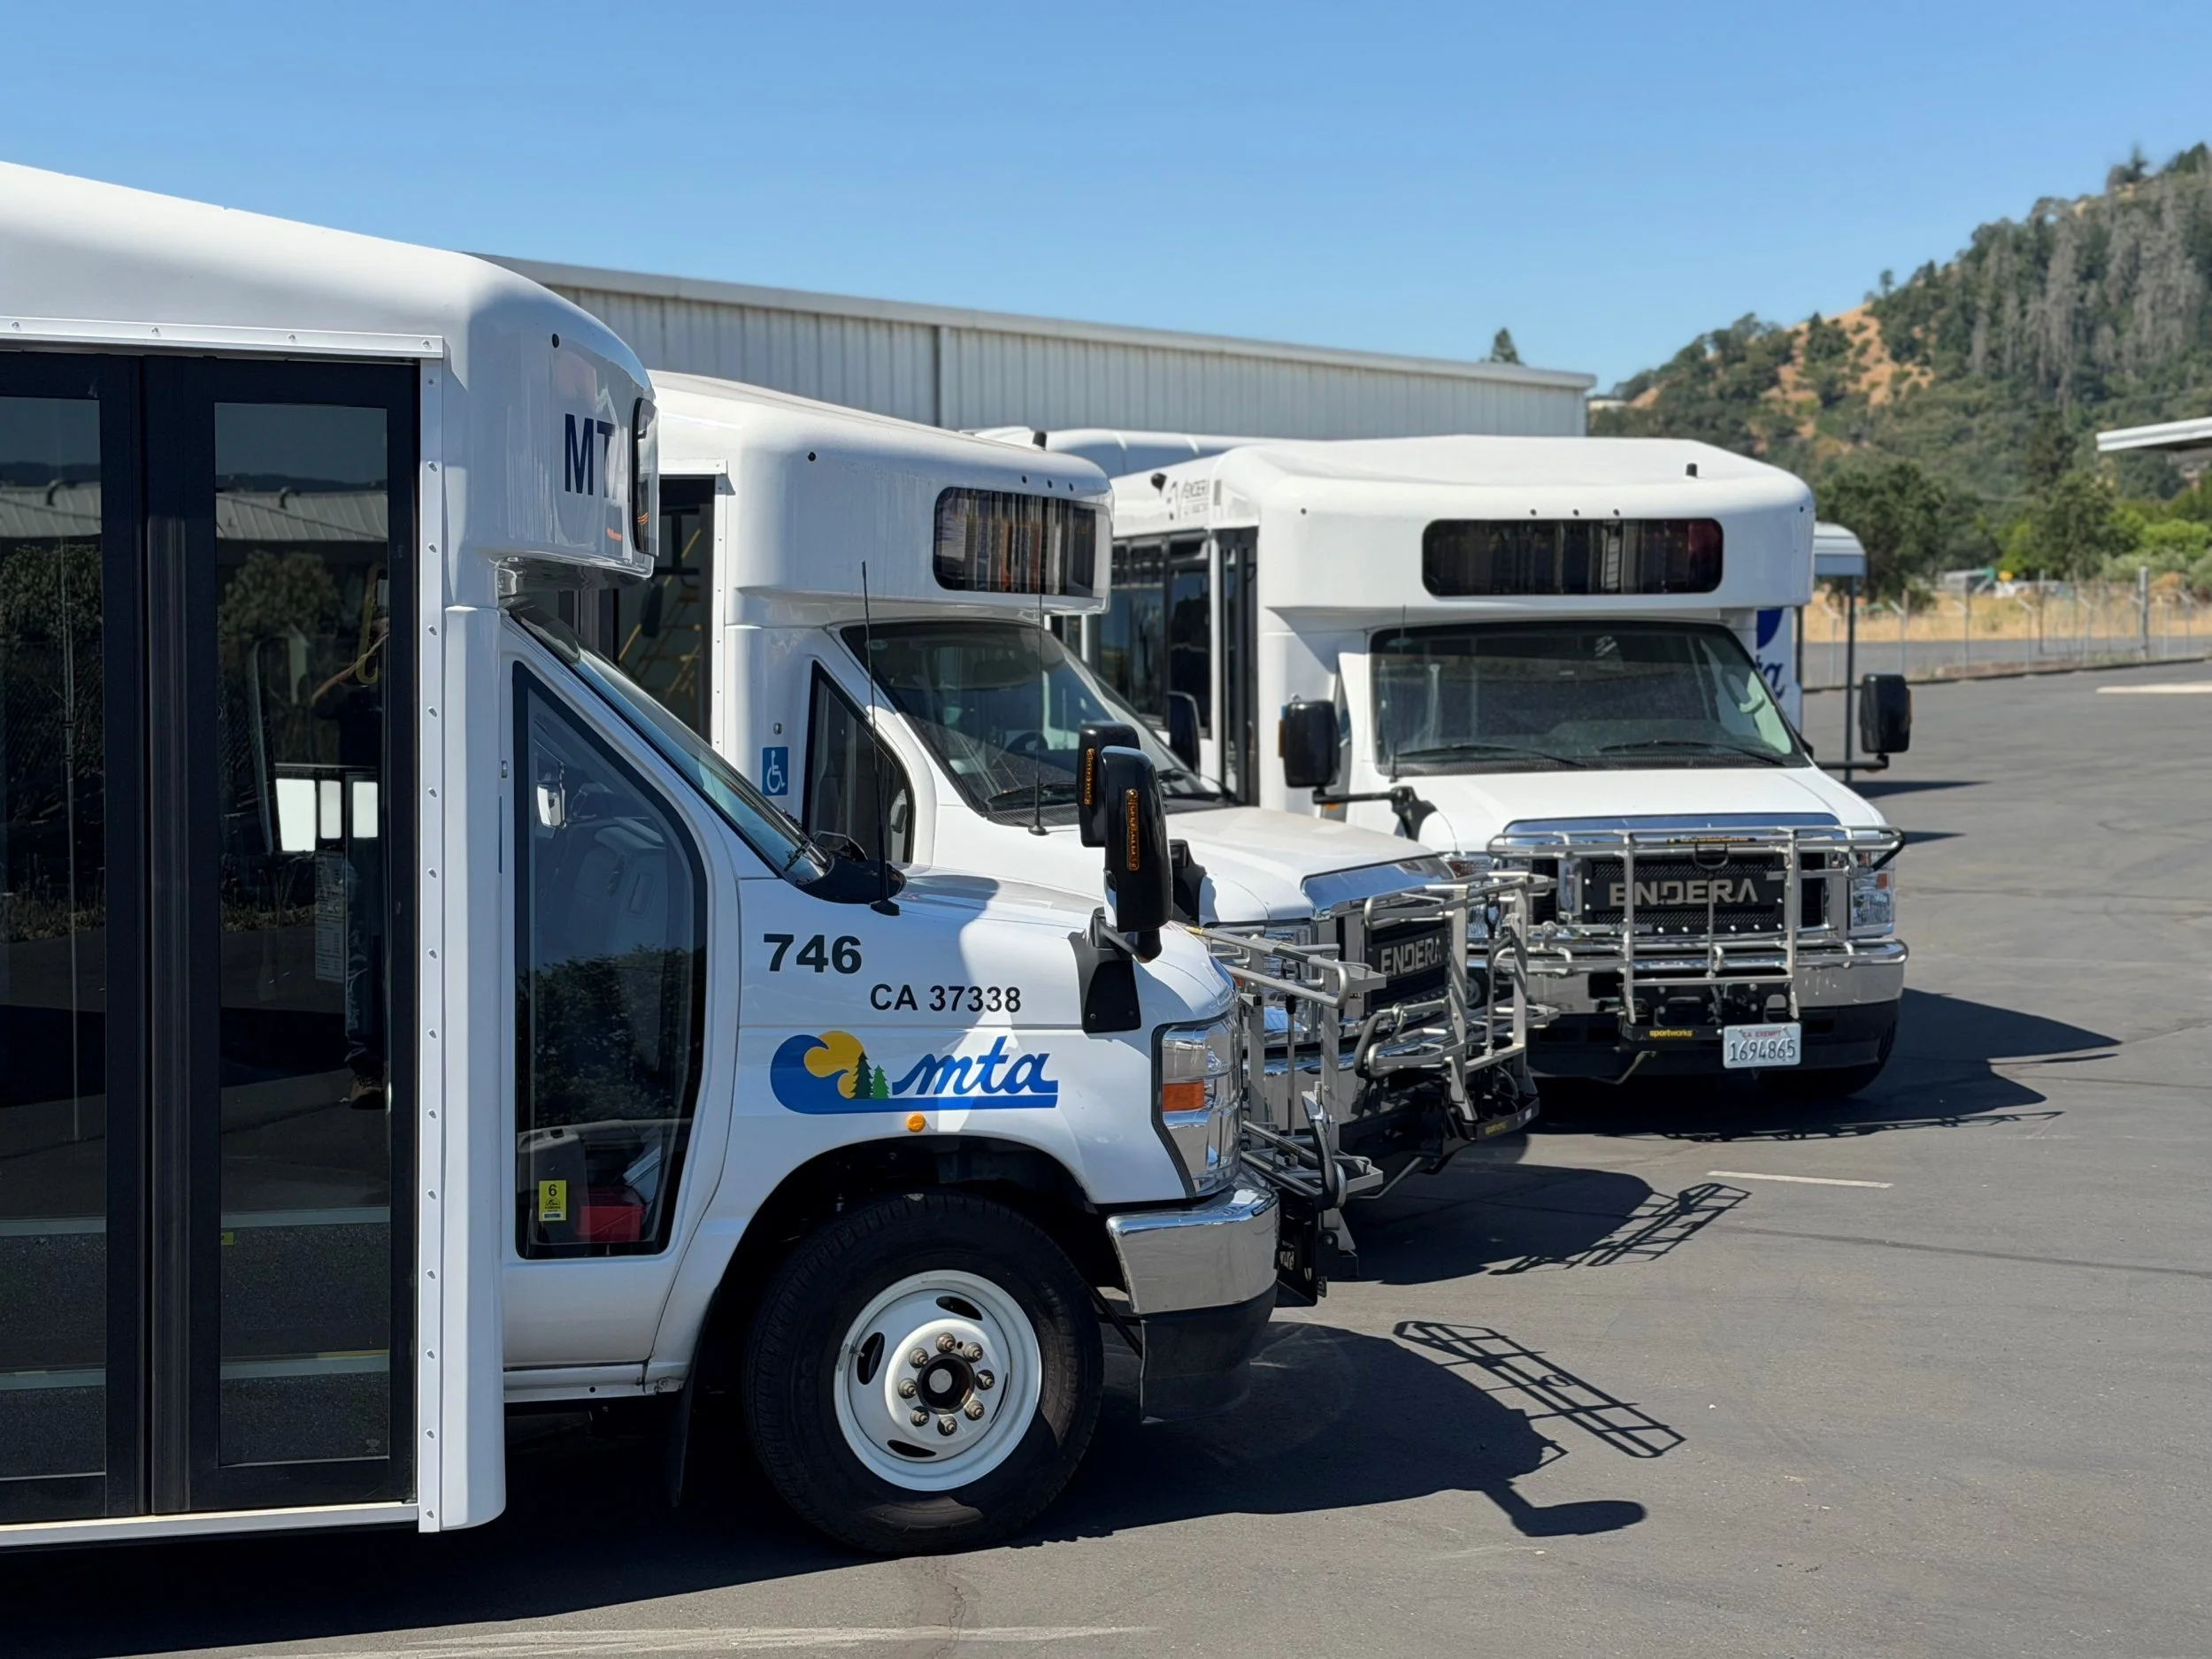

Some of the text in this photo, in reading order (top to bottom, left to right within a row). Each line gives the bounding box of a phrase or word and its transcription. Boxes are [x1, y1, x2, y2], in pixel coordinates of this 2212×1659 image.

[1609, 878, 1759, 907] ENDERA
[764, 933, 861, 974] 746
[870, 984, 1021, 1013] CA 37338
[1729, 1038, 1795, 1062] 1694865
[892, 1035, 1058, 1095] mta
[549, 1184, 557, 1196] 6
